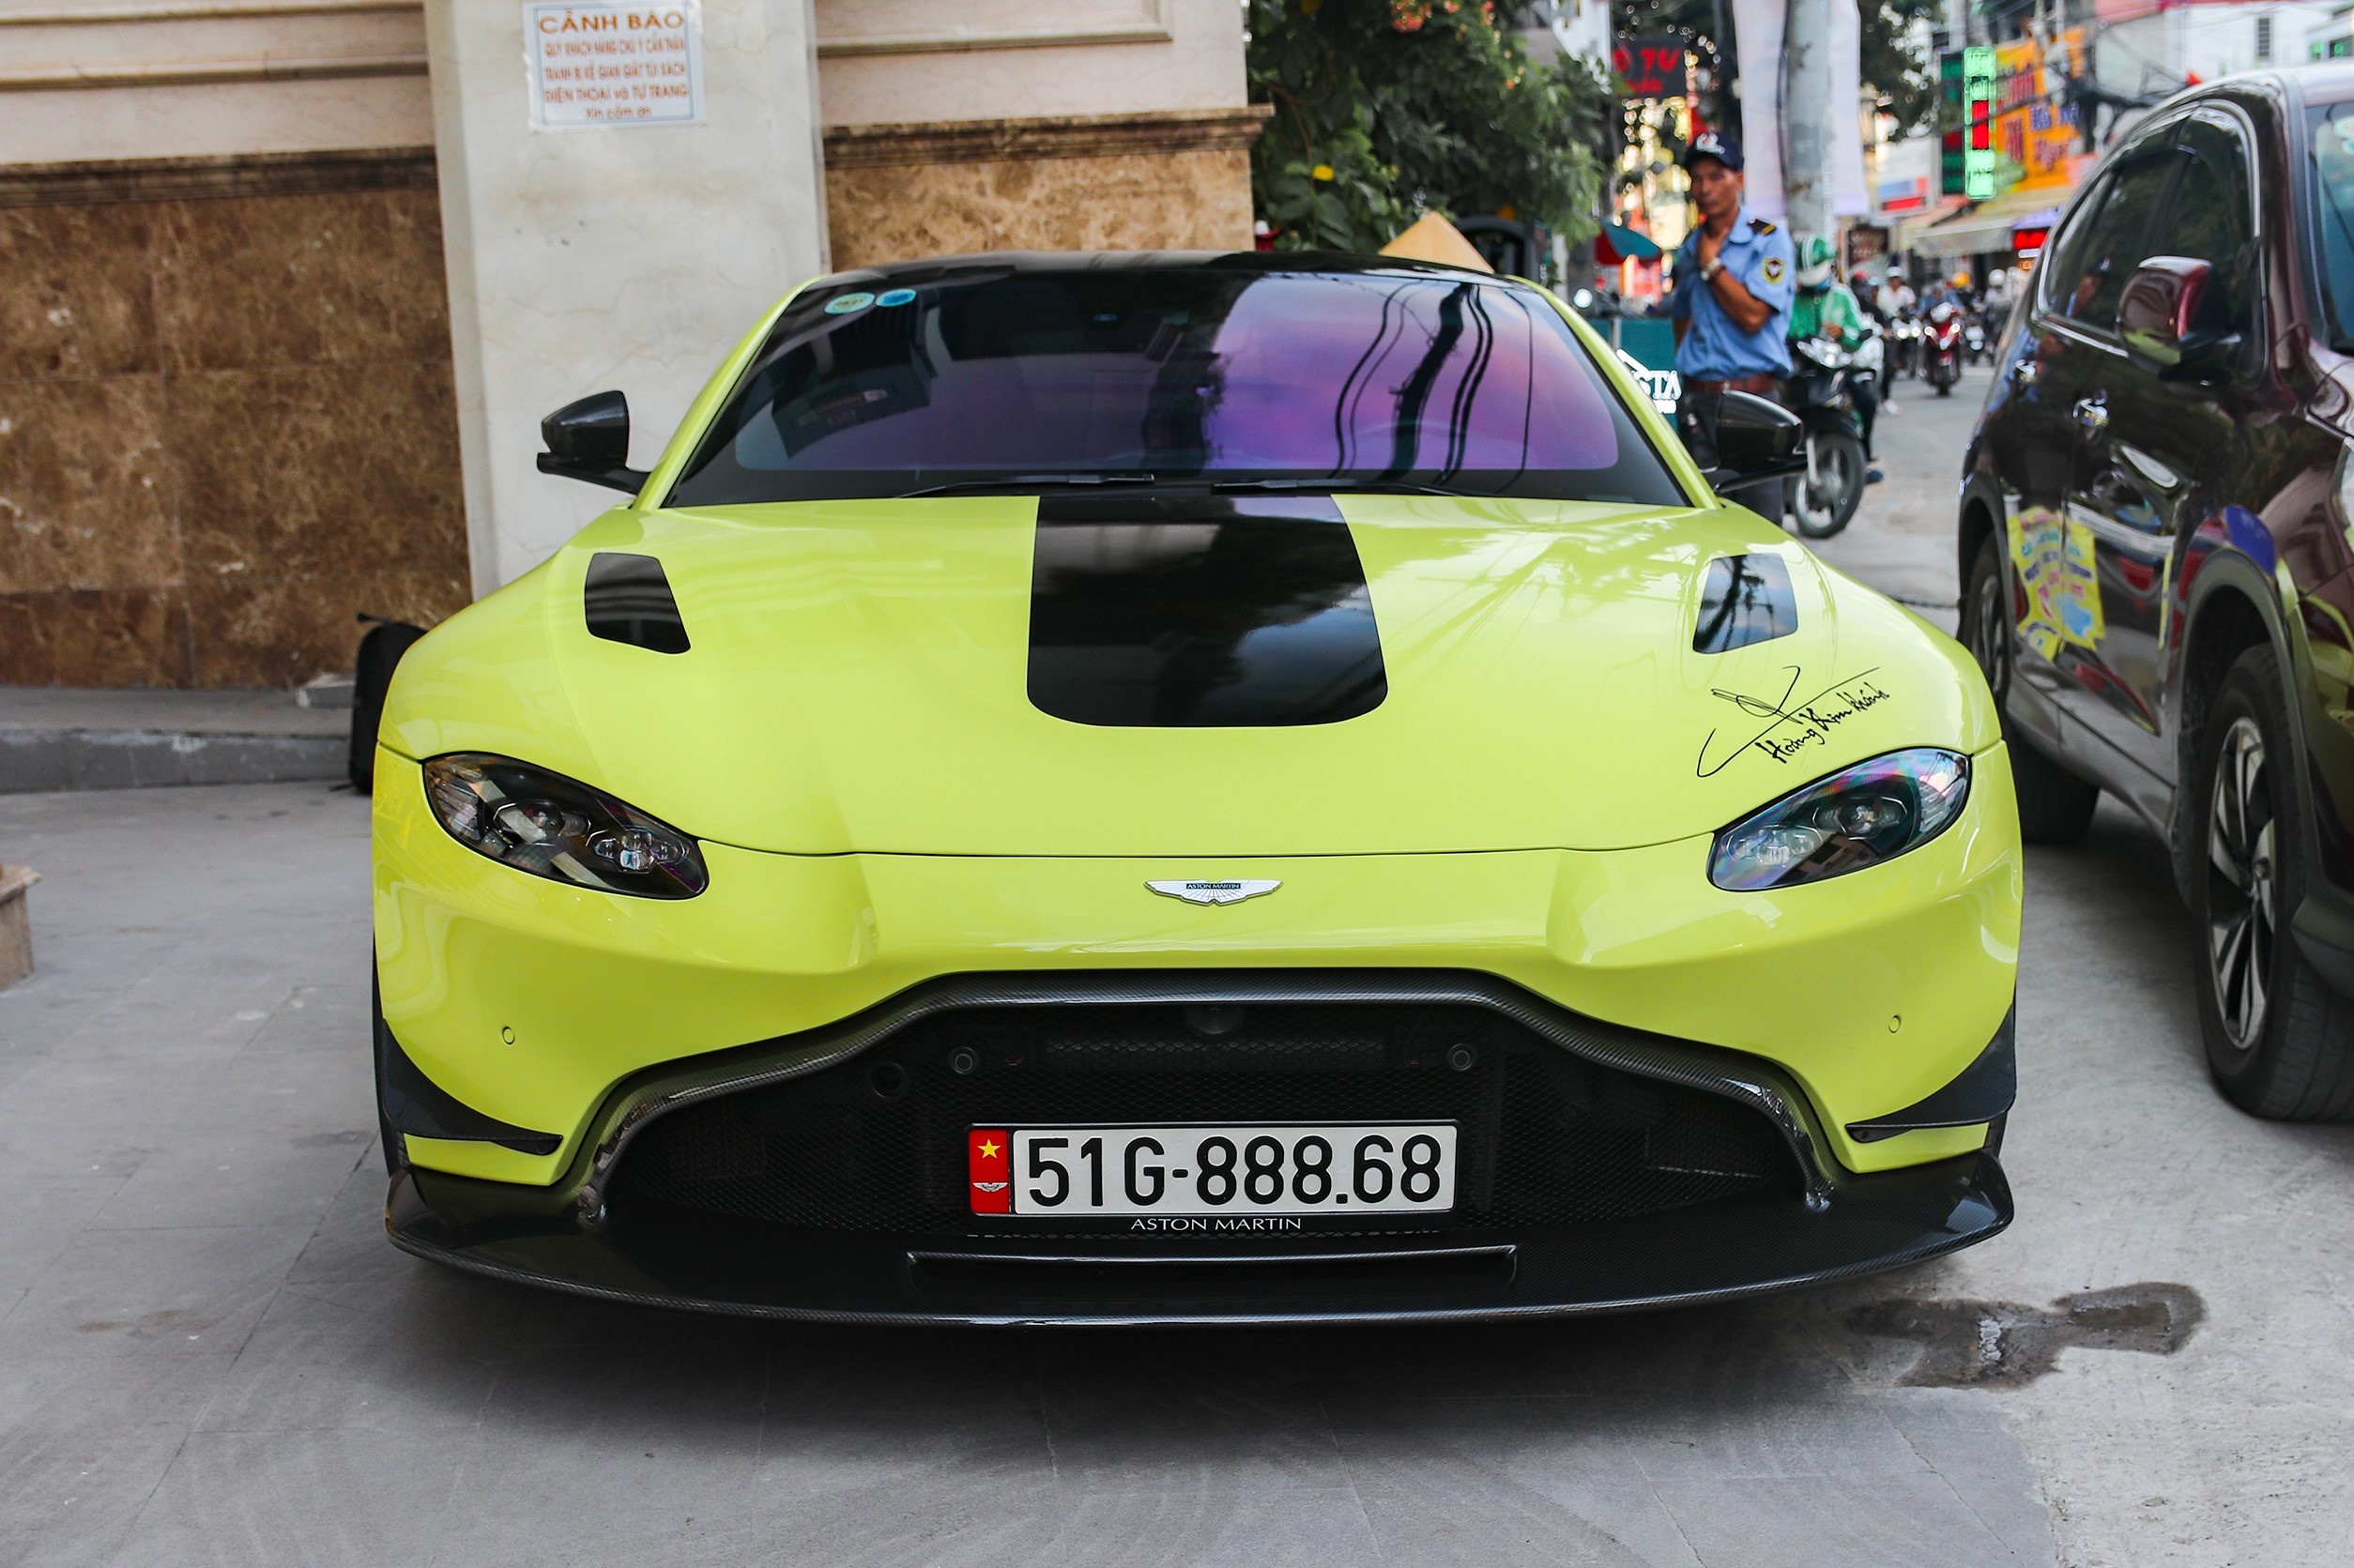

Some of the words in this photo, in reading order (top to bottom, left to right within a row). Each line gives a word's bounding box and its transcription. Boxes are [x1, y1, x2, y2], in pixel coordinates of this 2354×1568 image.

[539, 8, 619, 34] CẢNH
[628, 9, 684, 31] BÁO
[1029, 1134, 1442, 1208] 51G-888.68
[1131, 1217, 1206, 1231] ASTON
[1215, 1217, 1301, 1230] MARTIN
